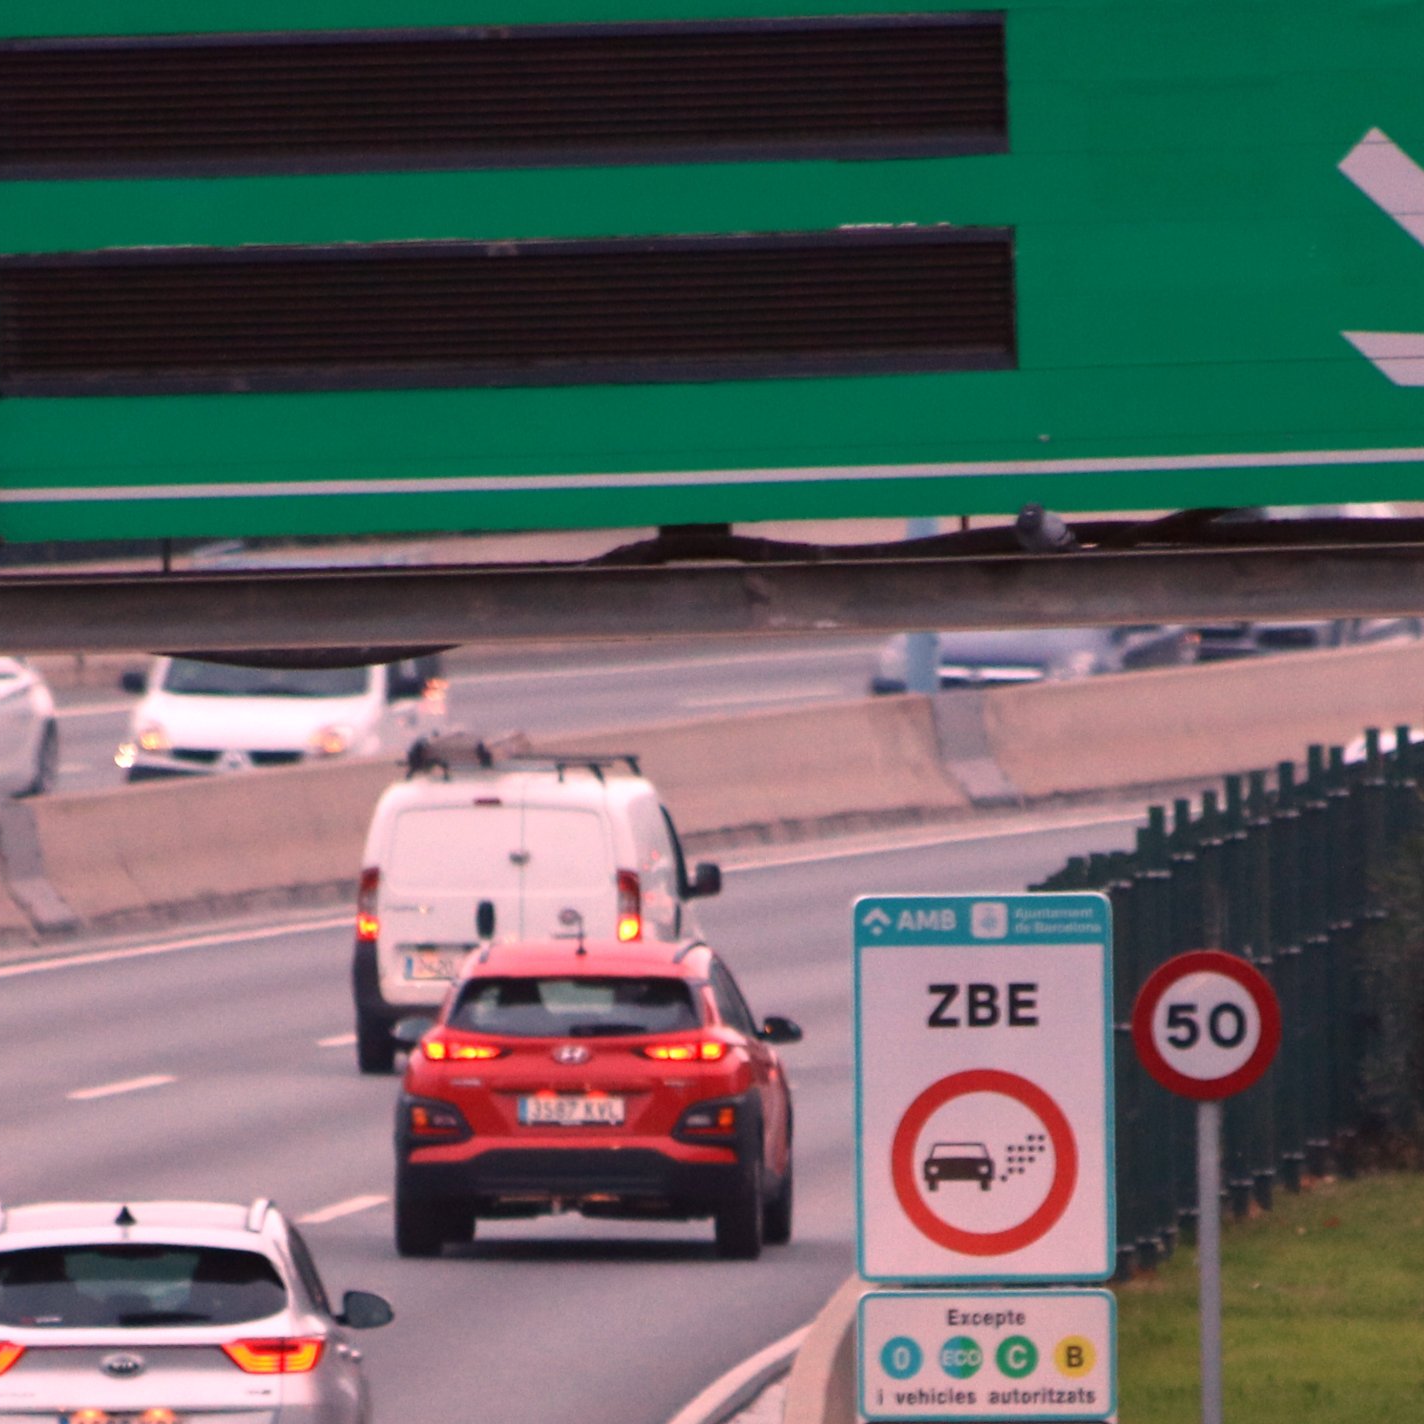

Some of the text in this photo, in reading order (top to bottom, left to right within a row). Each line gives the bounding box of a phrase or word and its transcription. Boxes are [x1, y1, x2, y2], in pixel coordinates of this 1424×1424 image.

[897, 909, 957, 931] AMB
[927, 982, 1039, 1028] ZBE
[1167, 1002, 1248, 1051] 50
[947, 1307, 1026, 1329] Excepte
[941, 1349, 982, 1367] ECO
[1007, 1345, 1027, 1370] C
[1065, 1345, 1084, 1369] B
[877, 1386, 1096, 1406] i vehicles autoritzats
